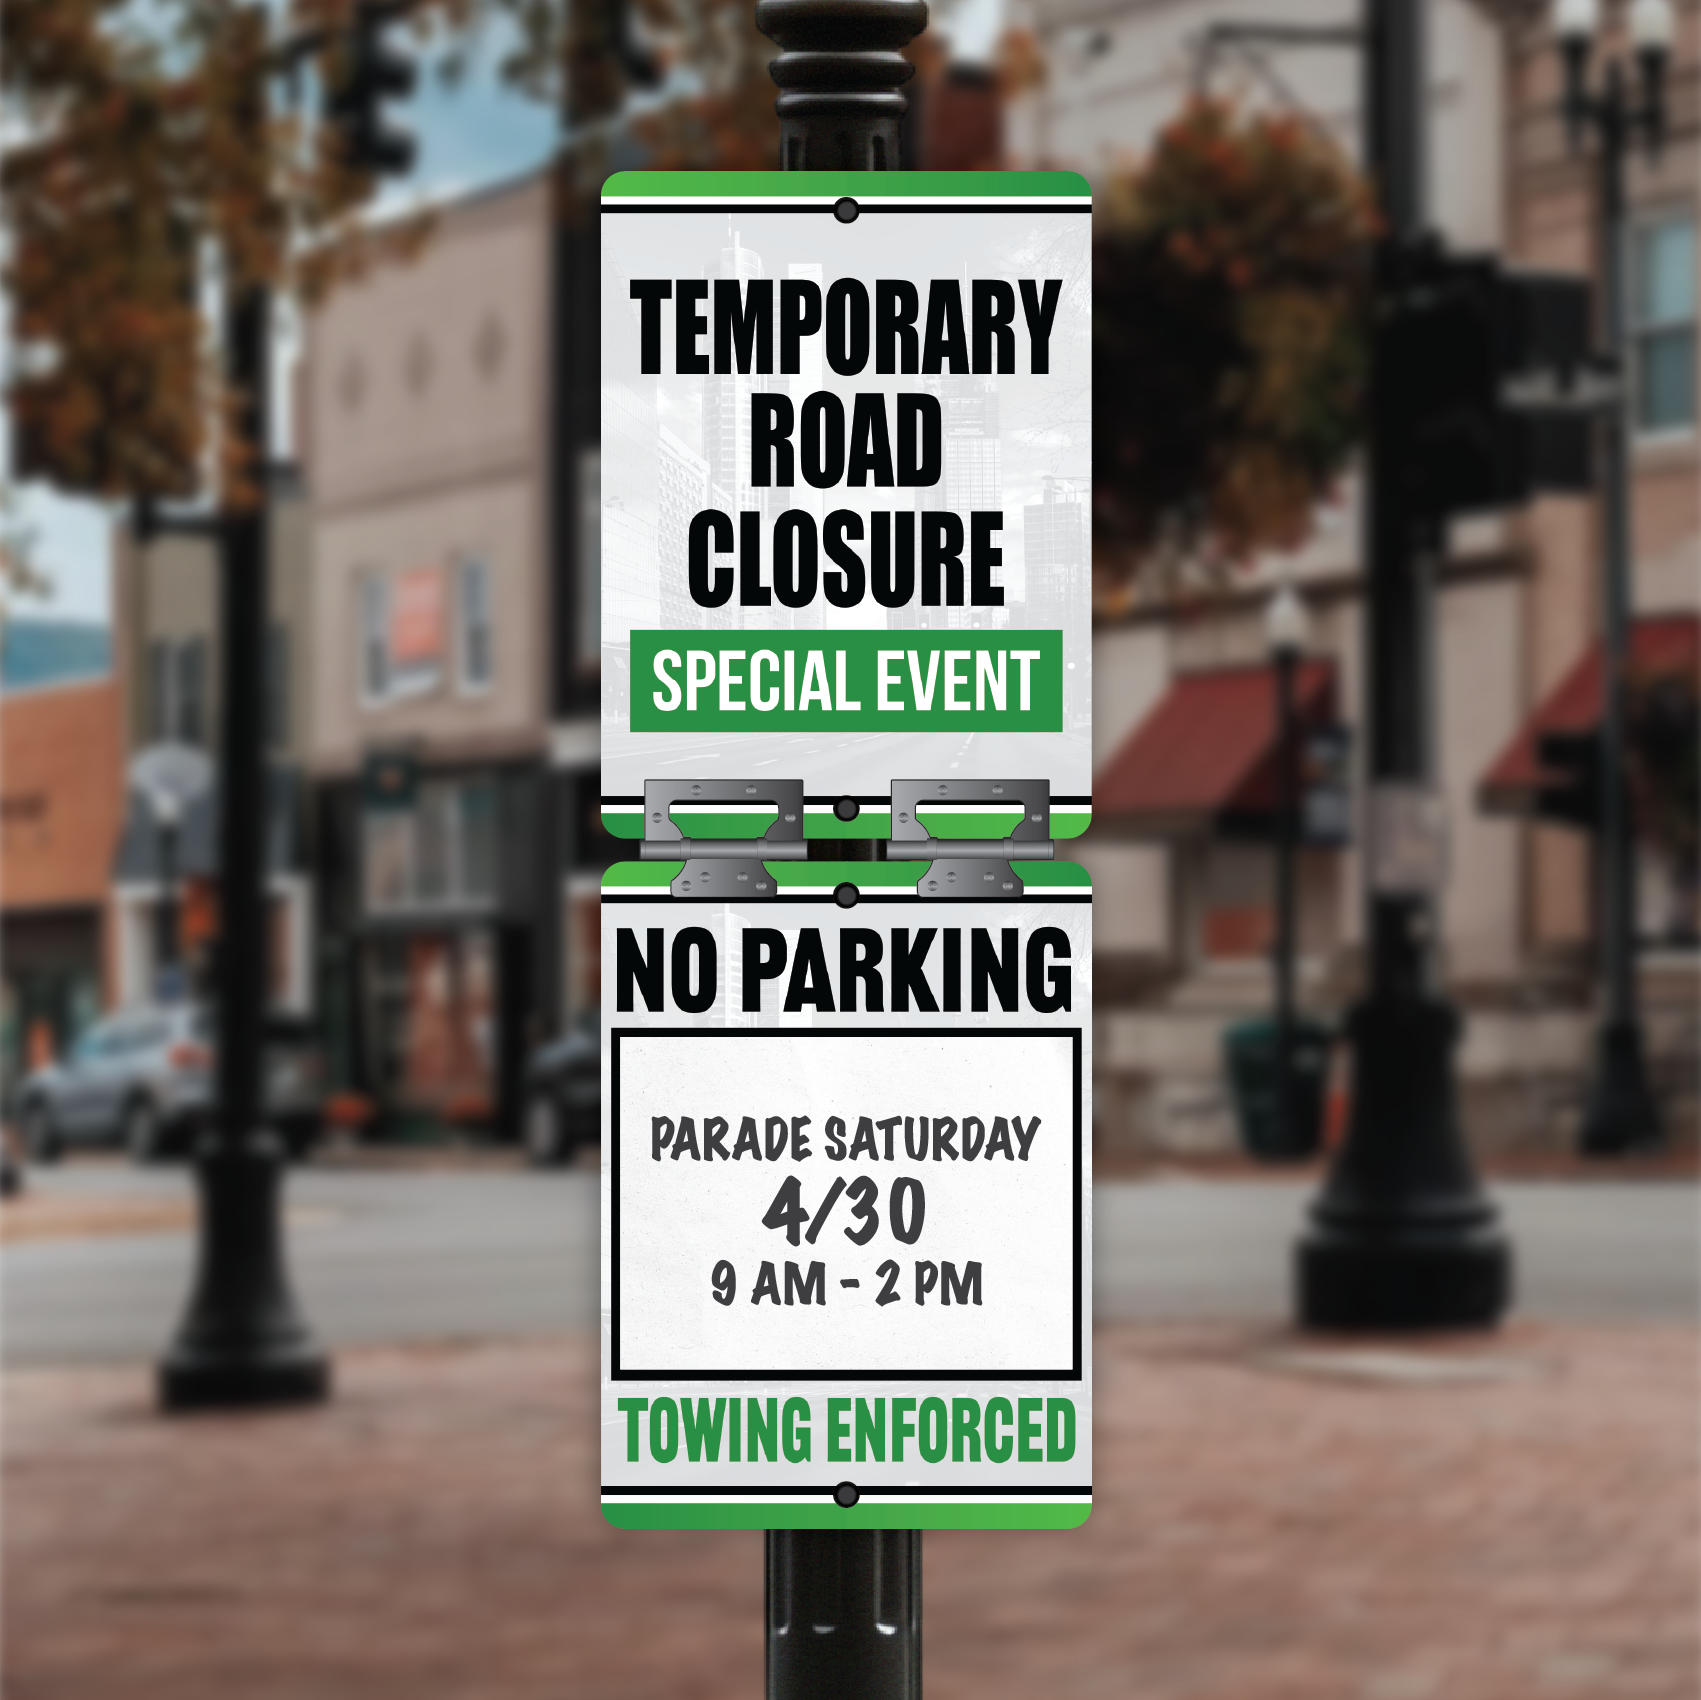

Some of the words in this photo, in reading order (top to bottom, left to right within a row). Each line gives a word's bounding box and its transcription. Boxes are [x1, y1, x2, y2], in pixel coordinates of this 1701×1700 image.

[630, 278, 1062, 376] TEMPORARY
[752, 391, 941, 488] ROAD
[689, 509, 1004, 608] CLOSURE
[653, 650, 860, 711] SPECIAL
[878, 651, 1040, 710] EVENT
[617, 927, 717, 1013] NO
[742, 927, 1071, 1013] PARKING
[652, 1116, 812, 1161] PARADE
[825, 1116, 1041, 1161] SATURDAY
[762, 1176, 925, 1246] 4/30
[712, 1260, 735, 1305] 9
[751, 1261, 825, 1305] AM
[840, 1279, 859, 1288] -
[876, 1260, 900, 1306] 2
[915, 1261, 982, 1306] PM
[618, 1397, 810, 1463] TOWING
[828, 1397, 1075, 1463] ENFORCED
